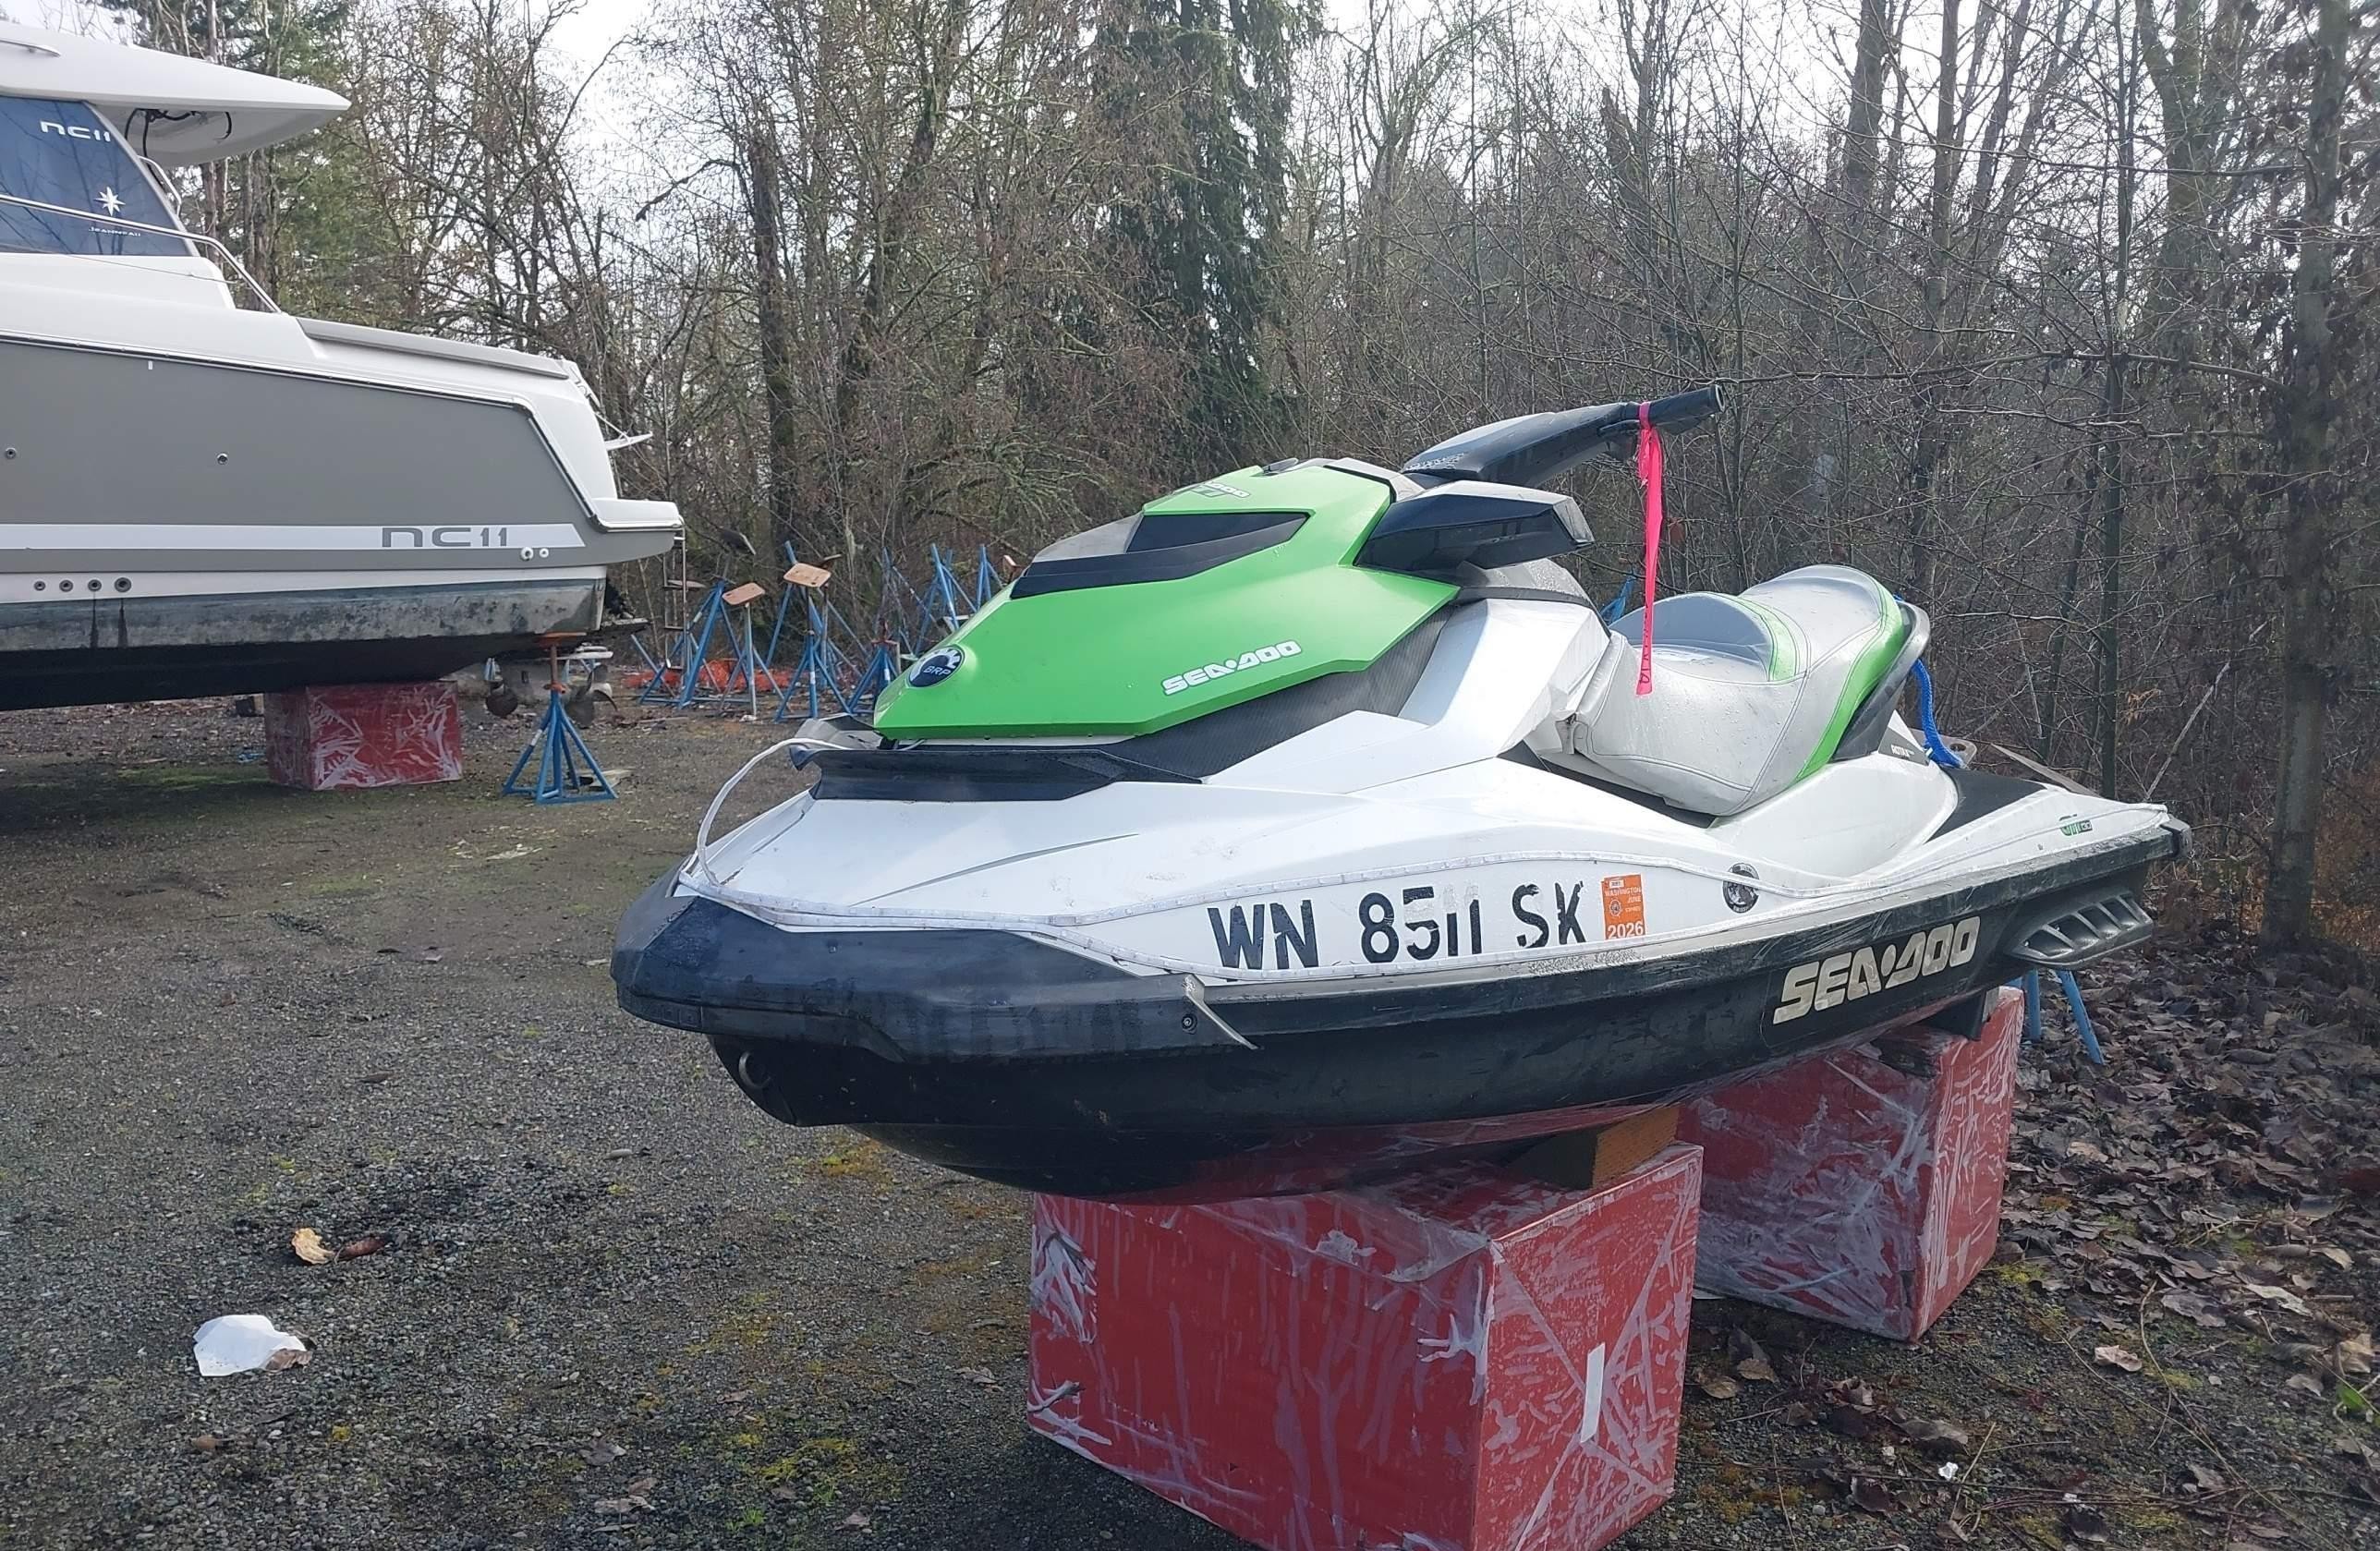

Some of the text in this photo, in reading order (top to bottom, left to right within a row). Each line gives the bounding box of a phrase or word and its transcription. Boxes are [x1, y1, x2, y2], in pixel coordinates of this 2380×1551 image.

[923, 665, 952, 676] BRP
[1207, 899, 1319, 970] WN
[1512, 880, 1587, 949] SK
[1607, 920, 1645, 939] 2026
